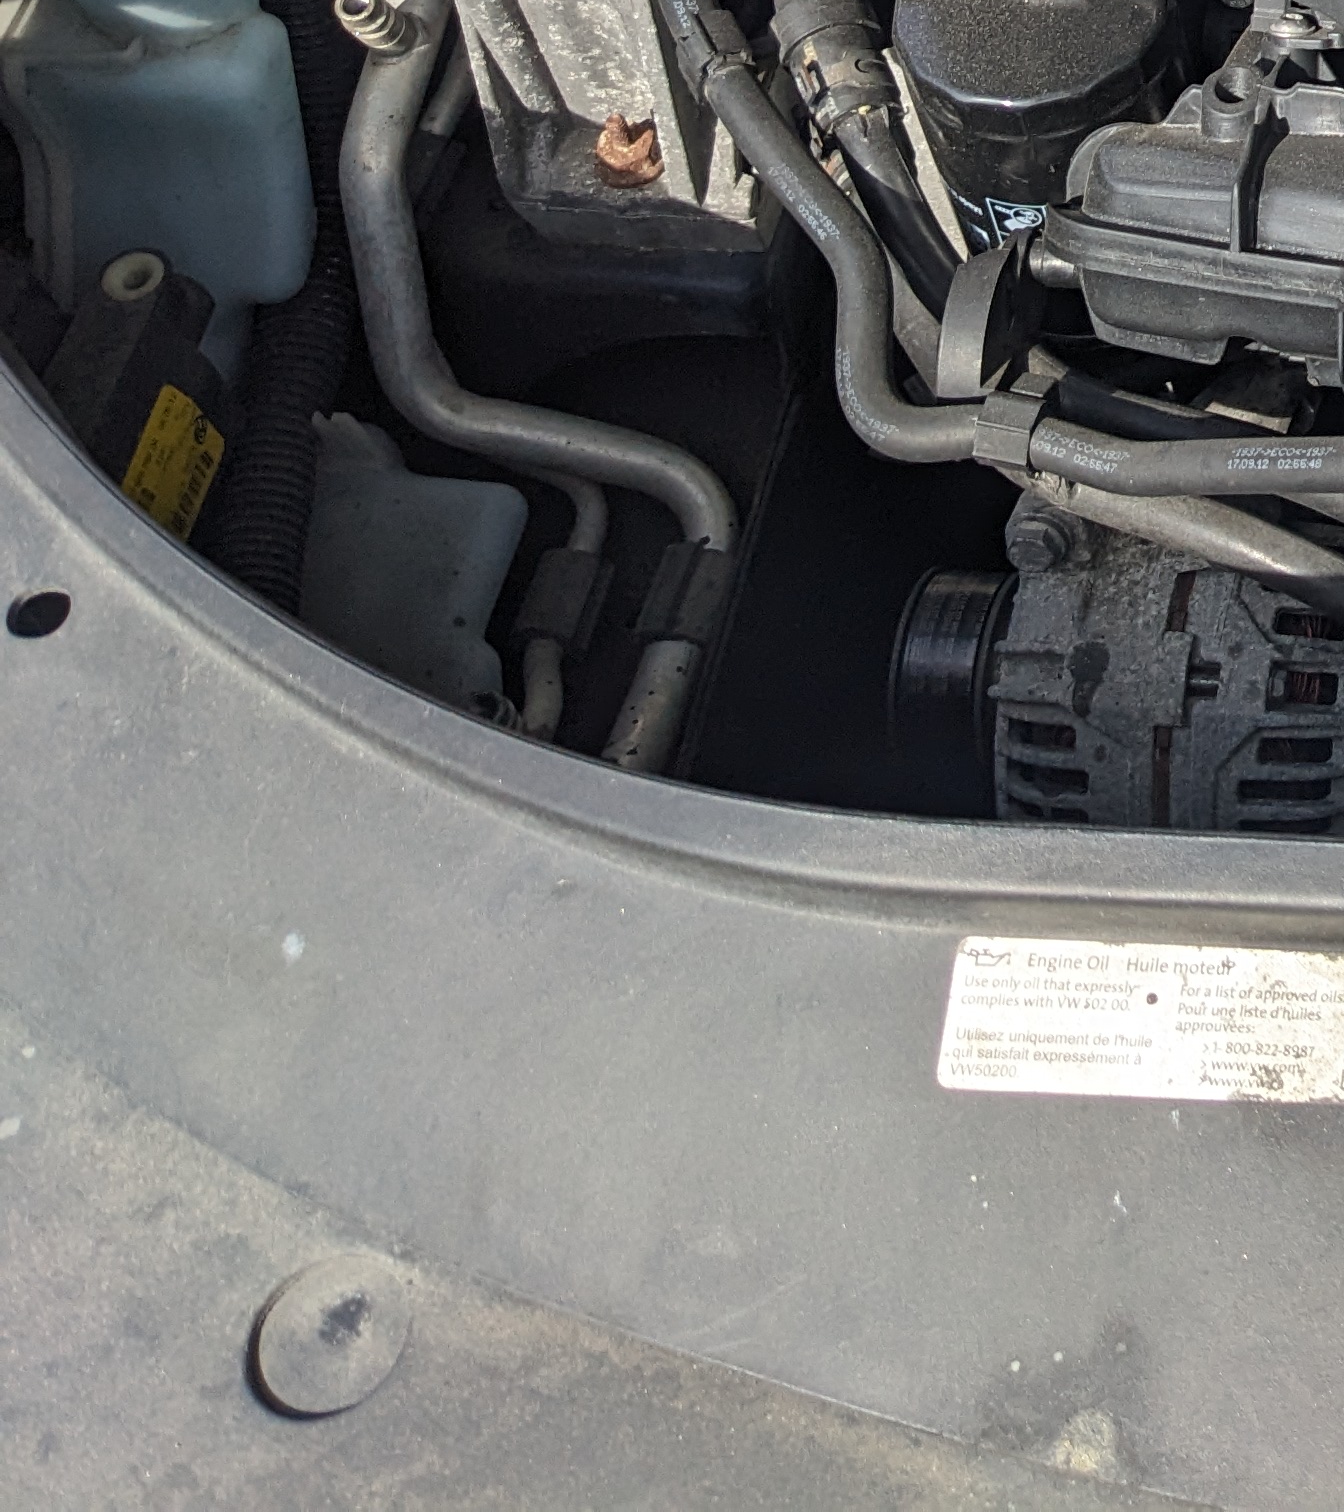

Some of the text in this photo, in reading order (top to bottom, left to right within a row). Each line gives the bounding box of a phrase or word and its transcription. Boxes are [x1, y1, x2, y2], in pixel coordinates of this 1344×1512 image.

[1026, 952, 1170, 974] Engine Oil Huile
[963, 974, 1135, 997] Use only oil that expressly
[1179, 983, 1317, 1005] For list approved
[959, 991, 1081, 1010] complies with VW
[1177, 1002, 1268, 1019] Pour une liste
[954, 1026, 1090, 1048] Utilisez uniquement
[951, 1045, 1030, 1061] qui satisfait
